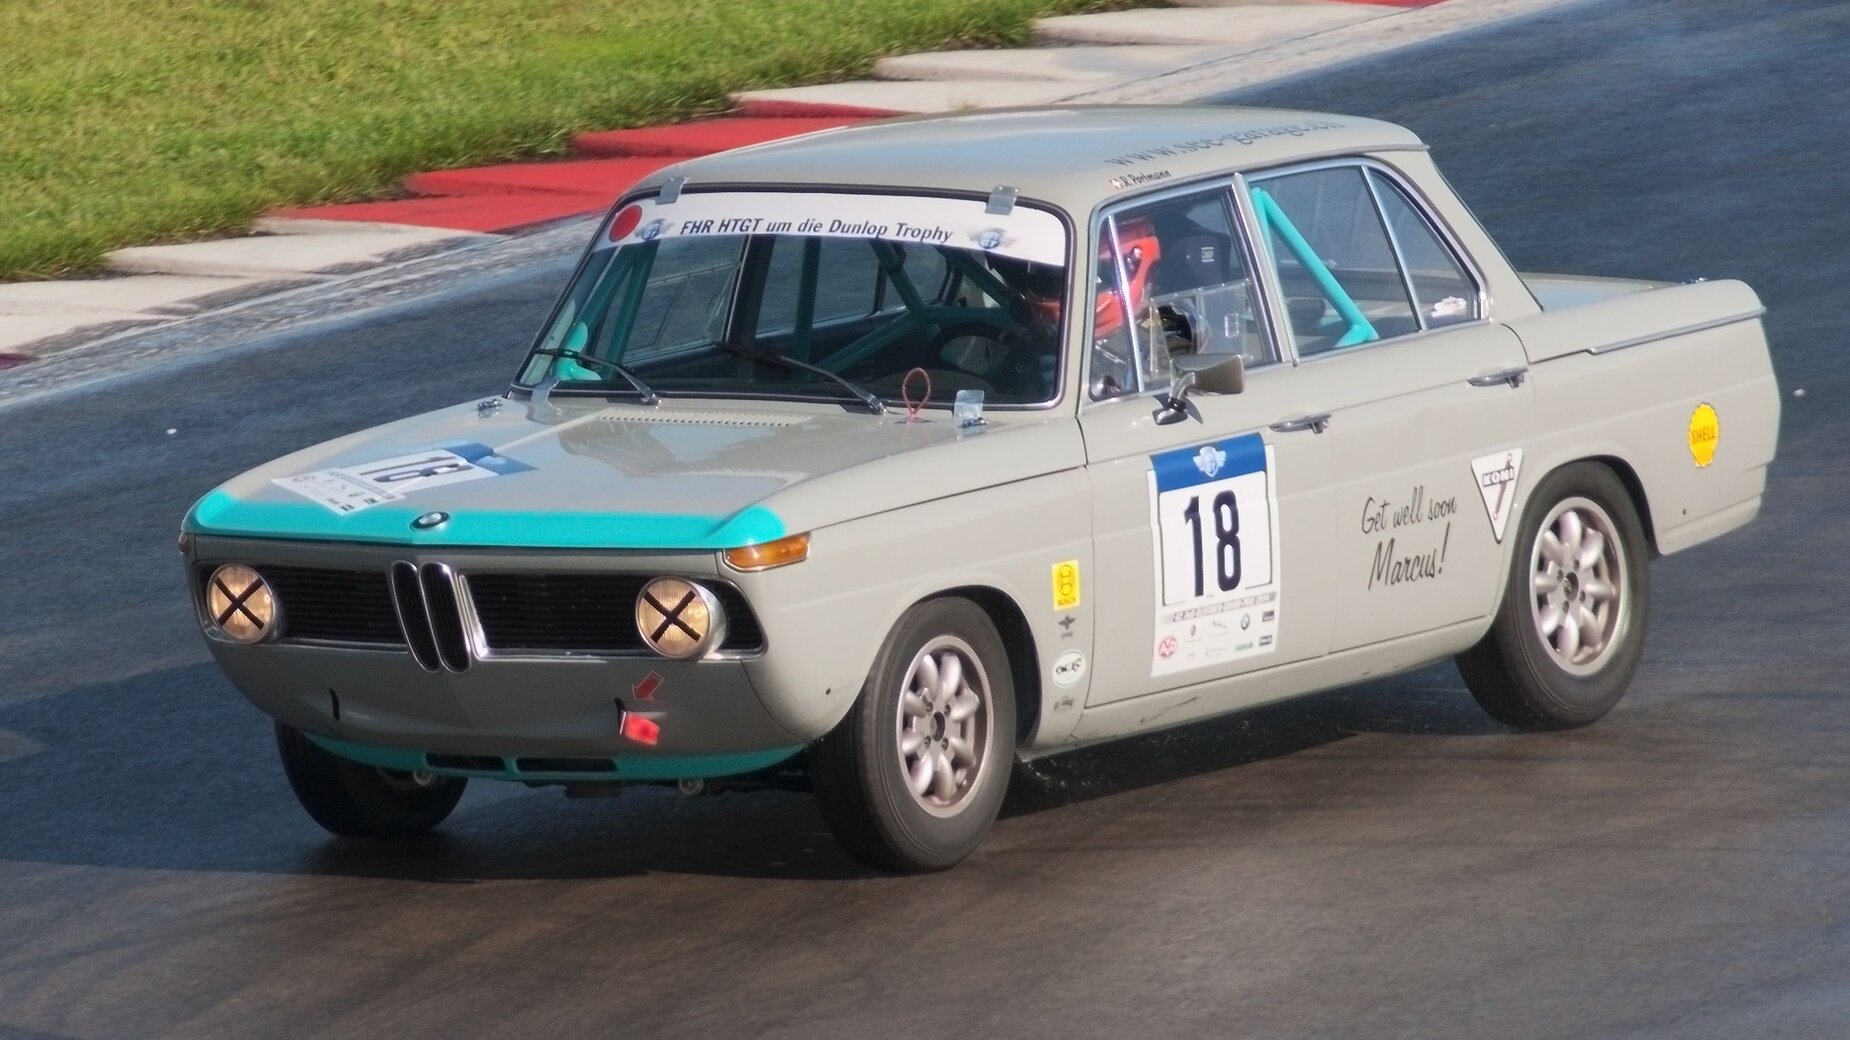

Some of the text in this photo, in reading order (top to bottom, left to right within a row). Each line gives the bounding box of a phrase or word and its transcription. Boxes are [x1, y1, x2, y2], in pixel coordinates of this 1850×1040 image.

[1130, 169, 1172, 186] Portmann
[680, 218, 954, 243] FHR HTGT um die Dunlop Trophy
[1691, 426, 1716, 445] SHELL
[1482, 469, 1515, 486] KONI
[1361, 485, 1457, 535] Get well soon
[1184, 489, 1242, 598] 18
[1368, 522, 1451, 590] Marcus!
